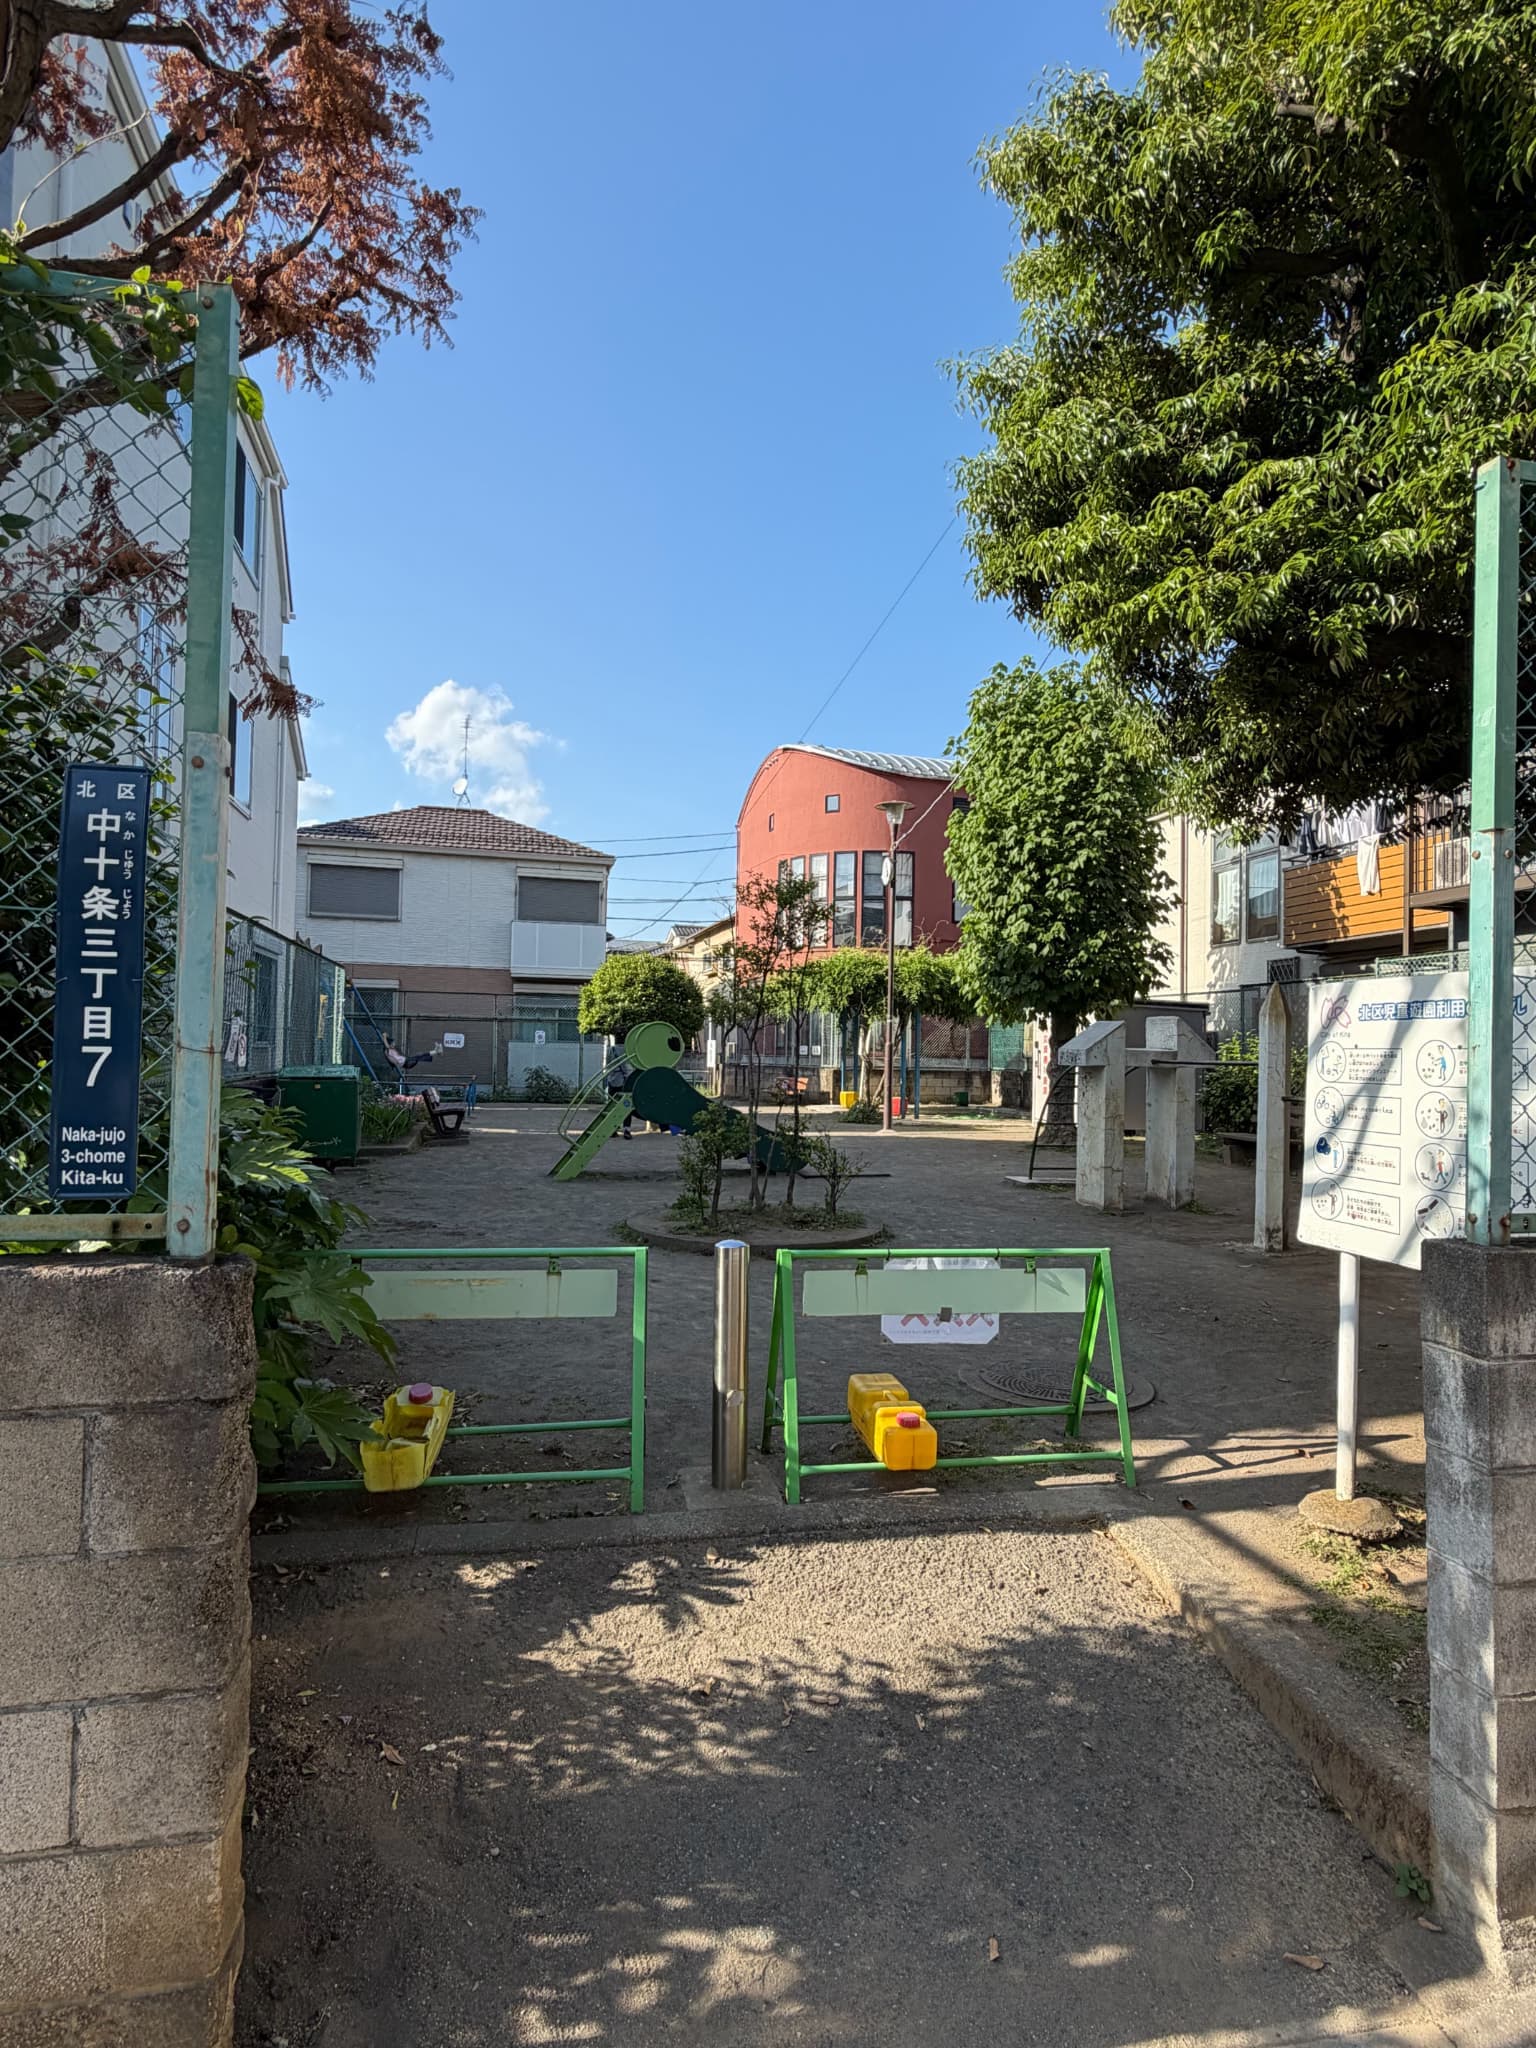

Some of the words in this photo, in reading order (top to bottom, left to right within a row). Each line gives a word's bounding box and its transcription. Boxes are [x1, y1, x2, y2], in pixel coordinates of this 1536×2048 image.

[61, 1126, 126, 1145] Naka-jujo
[61, 1148, 126, 1163] 3-chome
[61, 1169, 124, 1185] Kita-ku
